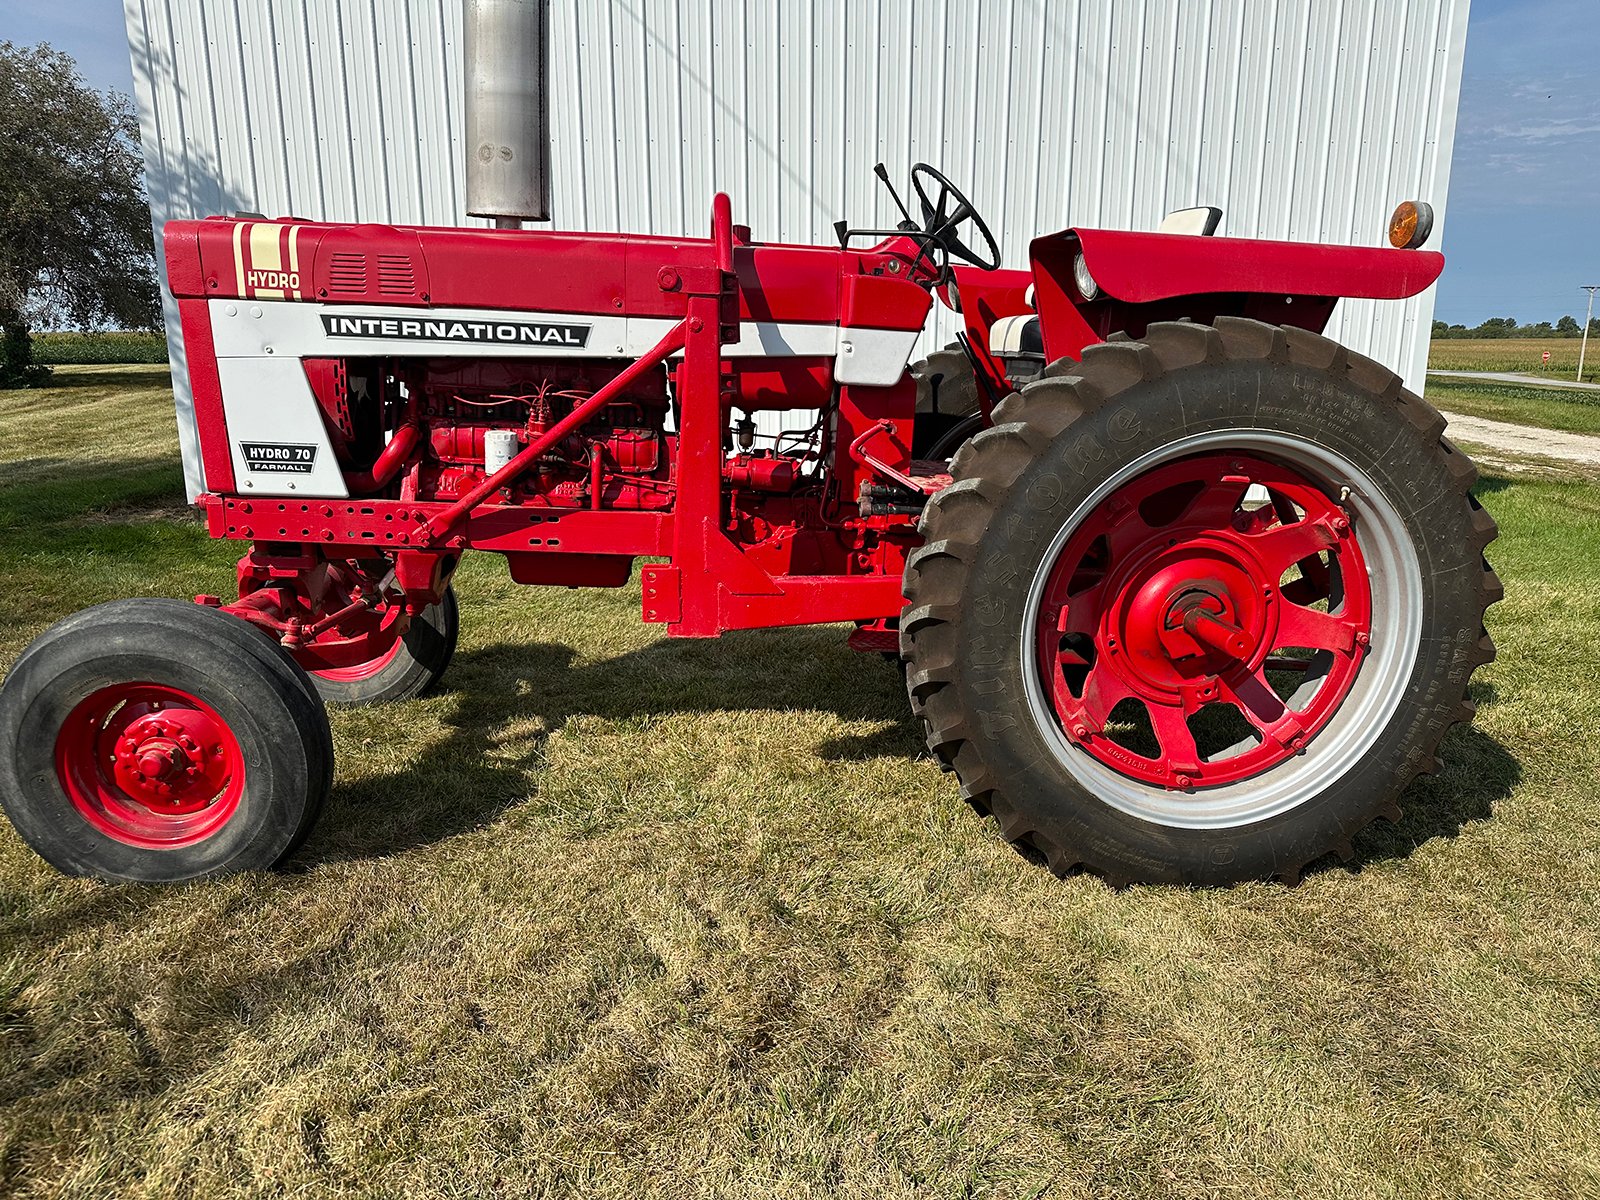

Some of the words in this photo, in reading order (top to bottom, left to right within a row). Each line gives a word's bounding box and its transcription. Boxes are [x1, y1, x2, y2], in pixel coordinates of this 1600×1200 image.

[247, 271, 300, 289] HYDRO
[330, 317, 580, 344] INTERNATIONAL
[249, 447, 290, 460] HYDRO
[295, 448, 311, 460] 70
[254, 463, 306, 471] FARMALL
